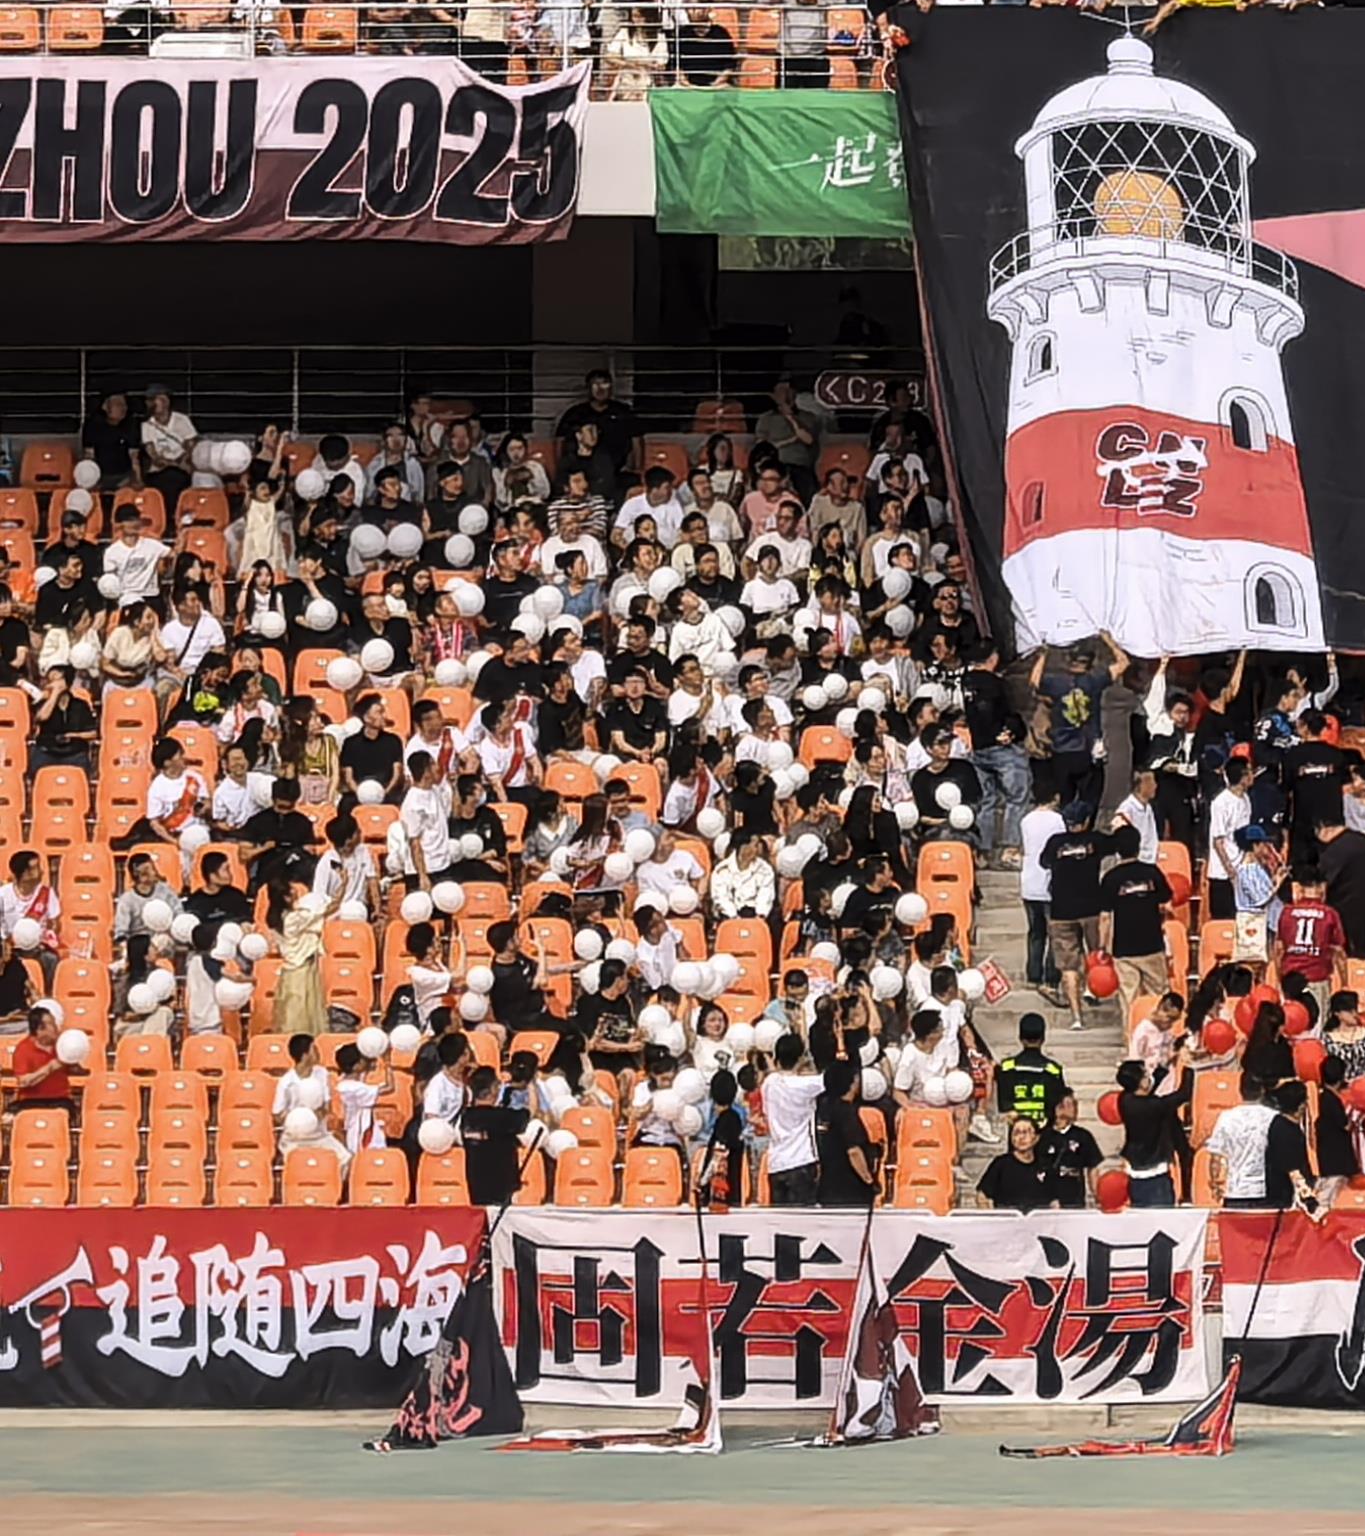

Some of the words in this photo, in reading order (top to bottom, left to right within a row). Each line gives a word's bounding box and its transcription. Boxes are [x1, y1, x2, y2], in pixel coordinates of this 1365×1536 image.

[286, 77, 578, 226] 2025
[1295, 917, 1315, 945] 11
[97, 1231, 468, 1377] 追随四海
